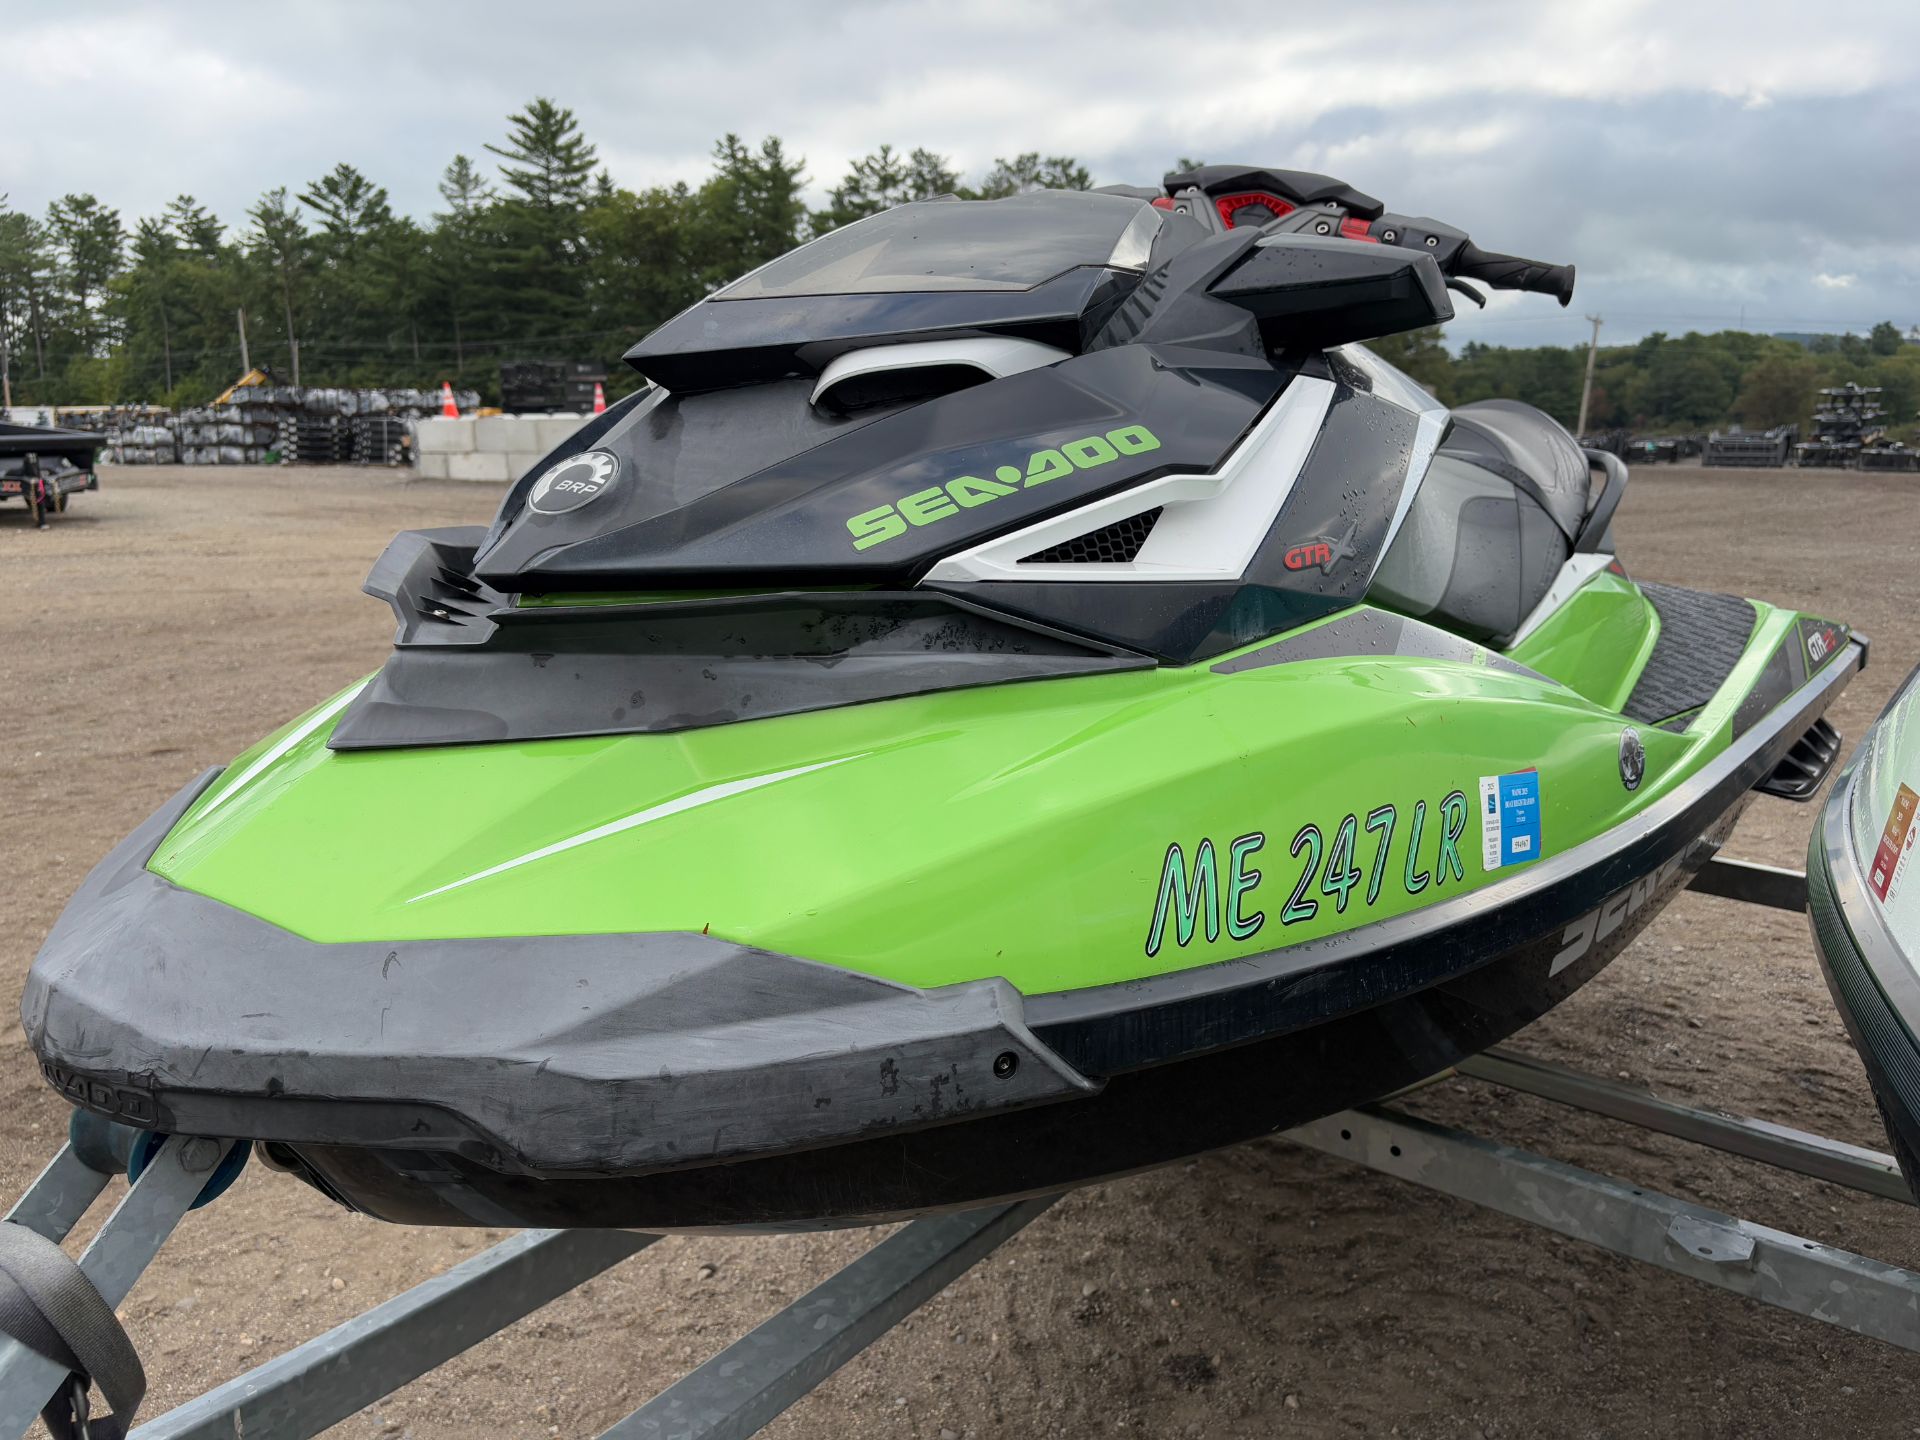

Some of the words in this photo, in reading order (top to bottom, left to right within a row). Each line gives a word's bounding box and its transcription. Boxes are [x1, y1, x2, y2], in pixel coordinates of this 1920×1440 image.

[554, 480, 598, 494] BRP
[1145, 831, 1265, 957] ME
[1280, 803, 1397, 925] 247
[1403, 789, 1468, 895] LR
